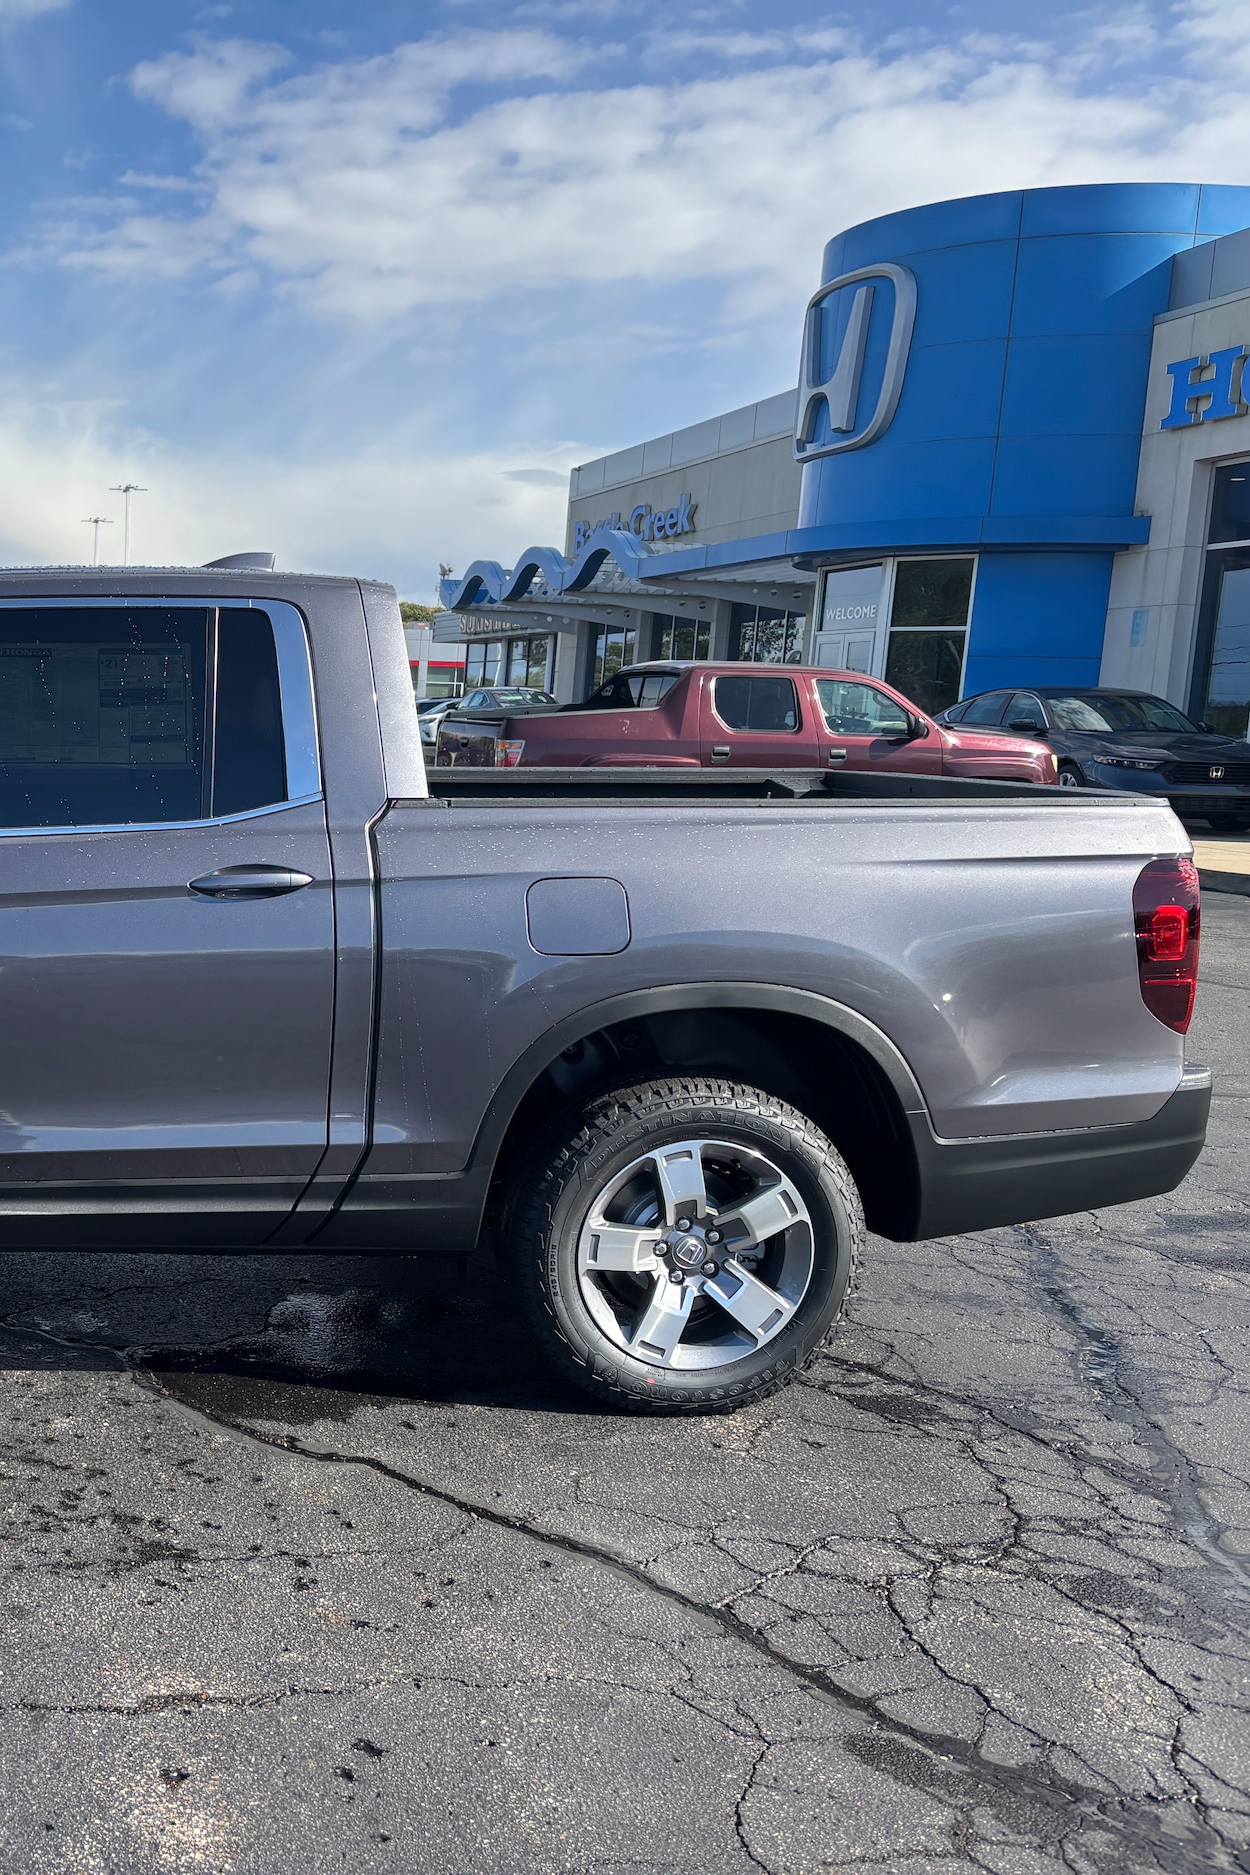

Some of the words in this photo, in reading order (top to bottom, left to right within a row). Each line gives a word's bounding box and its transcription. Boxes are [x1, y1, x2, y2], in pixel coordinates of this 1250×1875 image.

[630, 493, 696, 541] Creek
[826, 605, 876, 620] WELCOME
[4, 649, 50, 657] HONDA
[590, 1110, 787, 1168] DESTINATION
